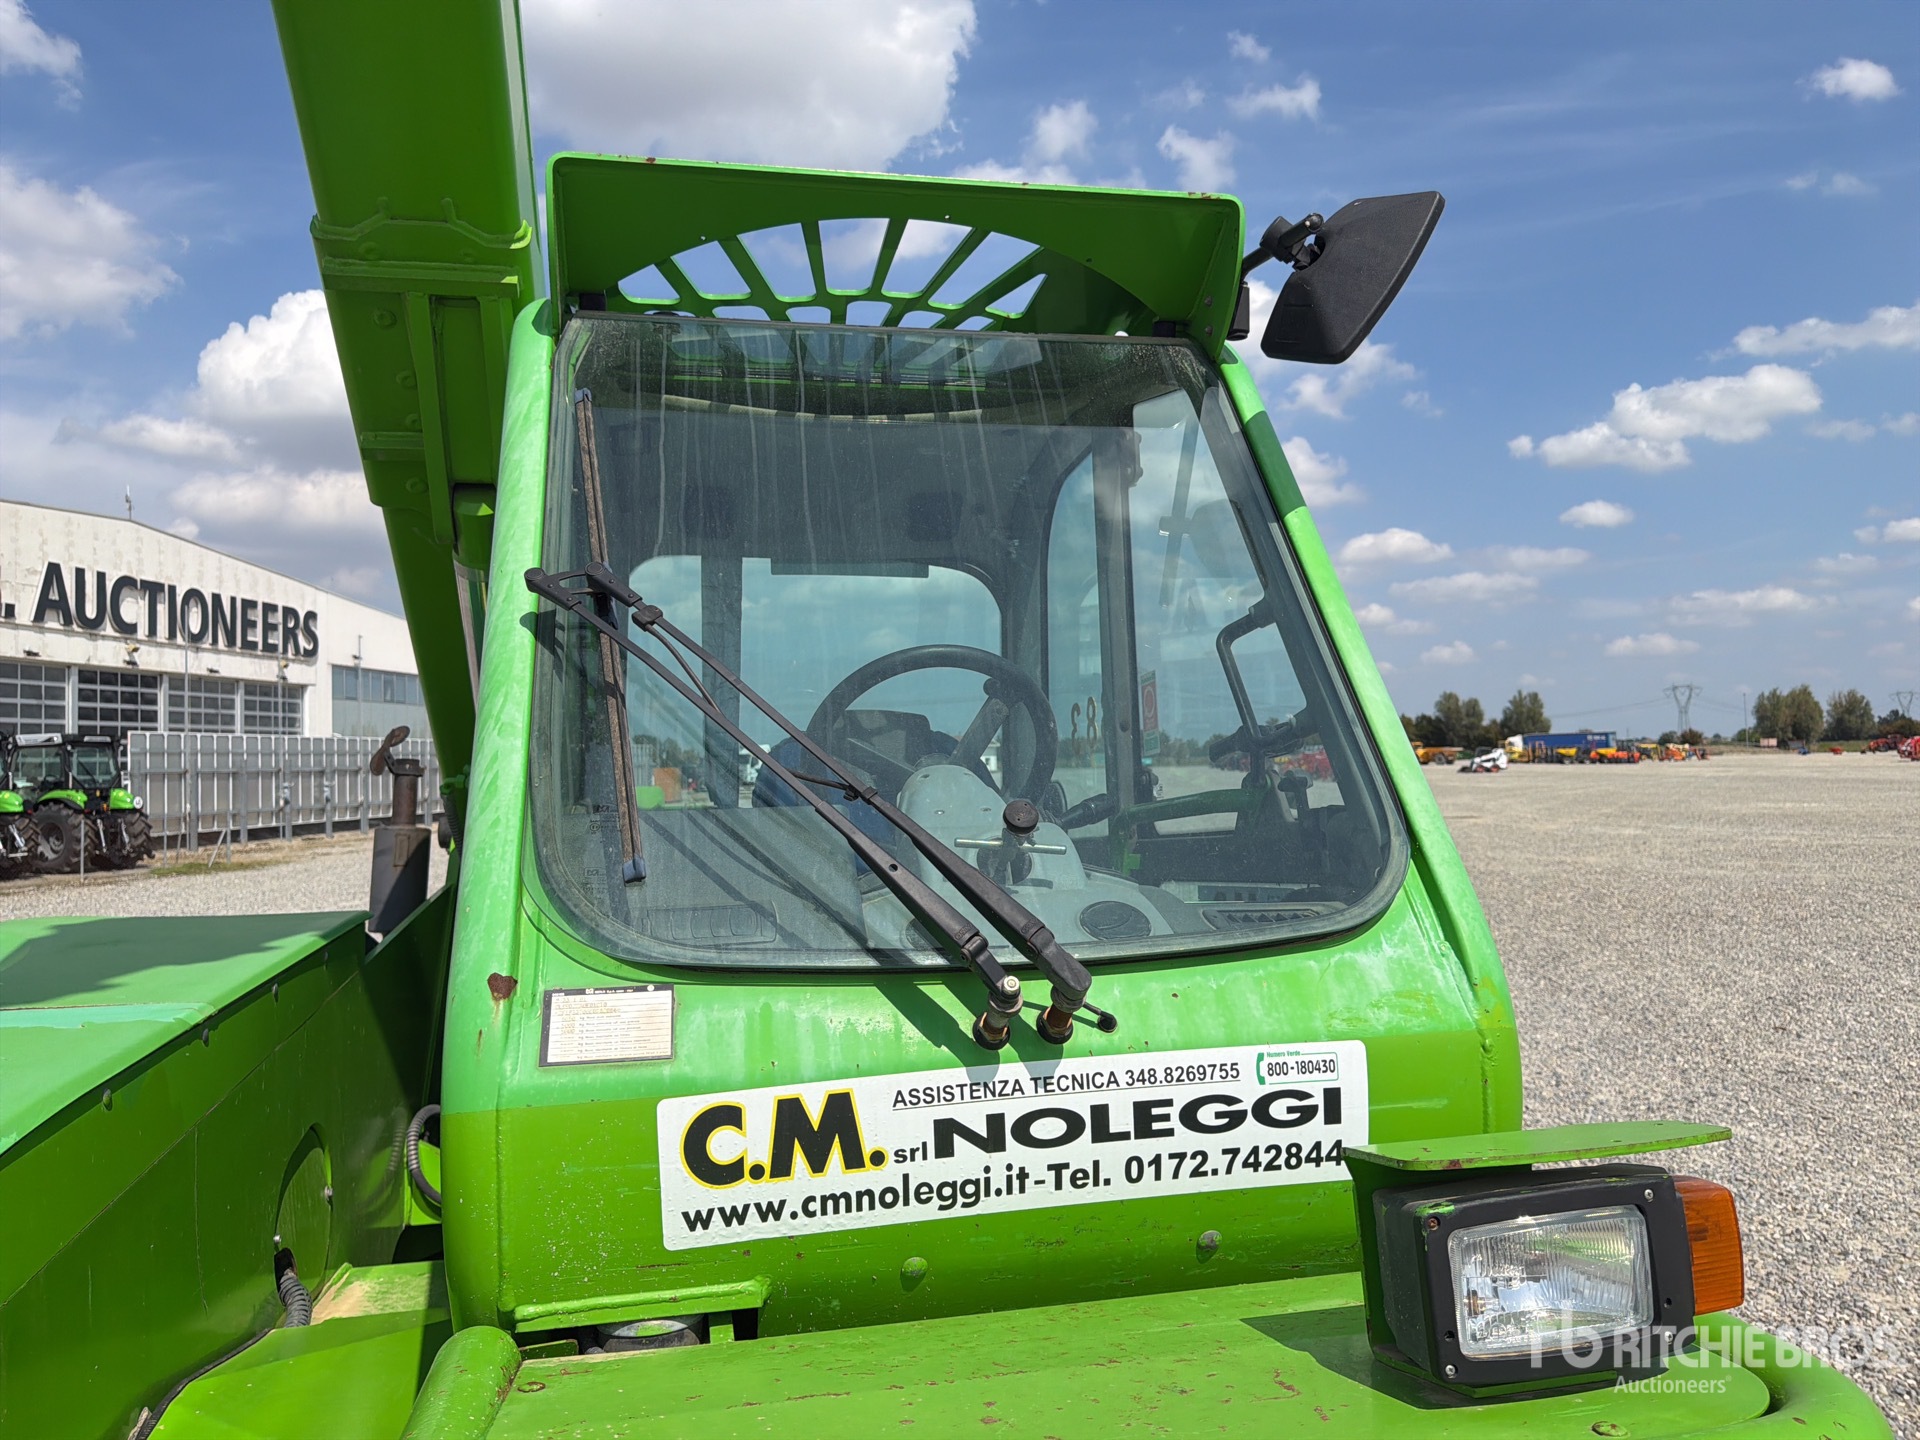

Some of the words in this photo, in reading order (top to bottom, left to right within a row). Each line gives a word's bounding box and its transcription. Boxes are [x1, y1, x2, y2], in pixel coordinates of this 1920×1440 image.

[32, 562, 319, 659] AUCTIONEERS
[892, 1079, 1025, 1108] ASSISTENZA
[1030, 1071, 1120, 1094] TECNICA
[1125, 1062, 1240, 1087] 348.8269755
[1267, 1059, 1336, 1077] 800-180430
[680, 1089, 889, 1190] C.M.
[893, 1141, 928, 1164] srl
[933, 1087, 1342, 1160] NOLEGGI
[1124, 1139, 1344, 1185] 0172.742844
